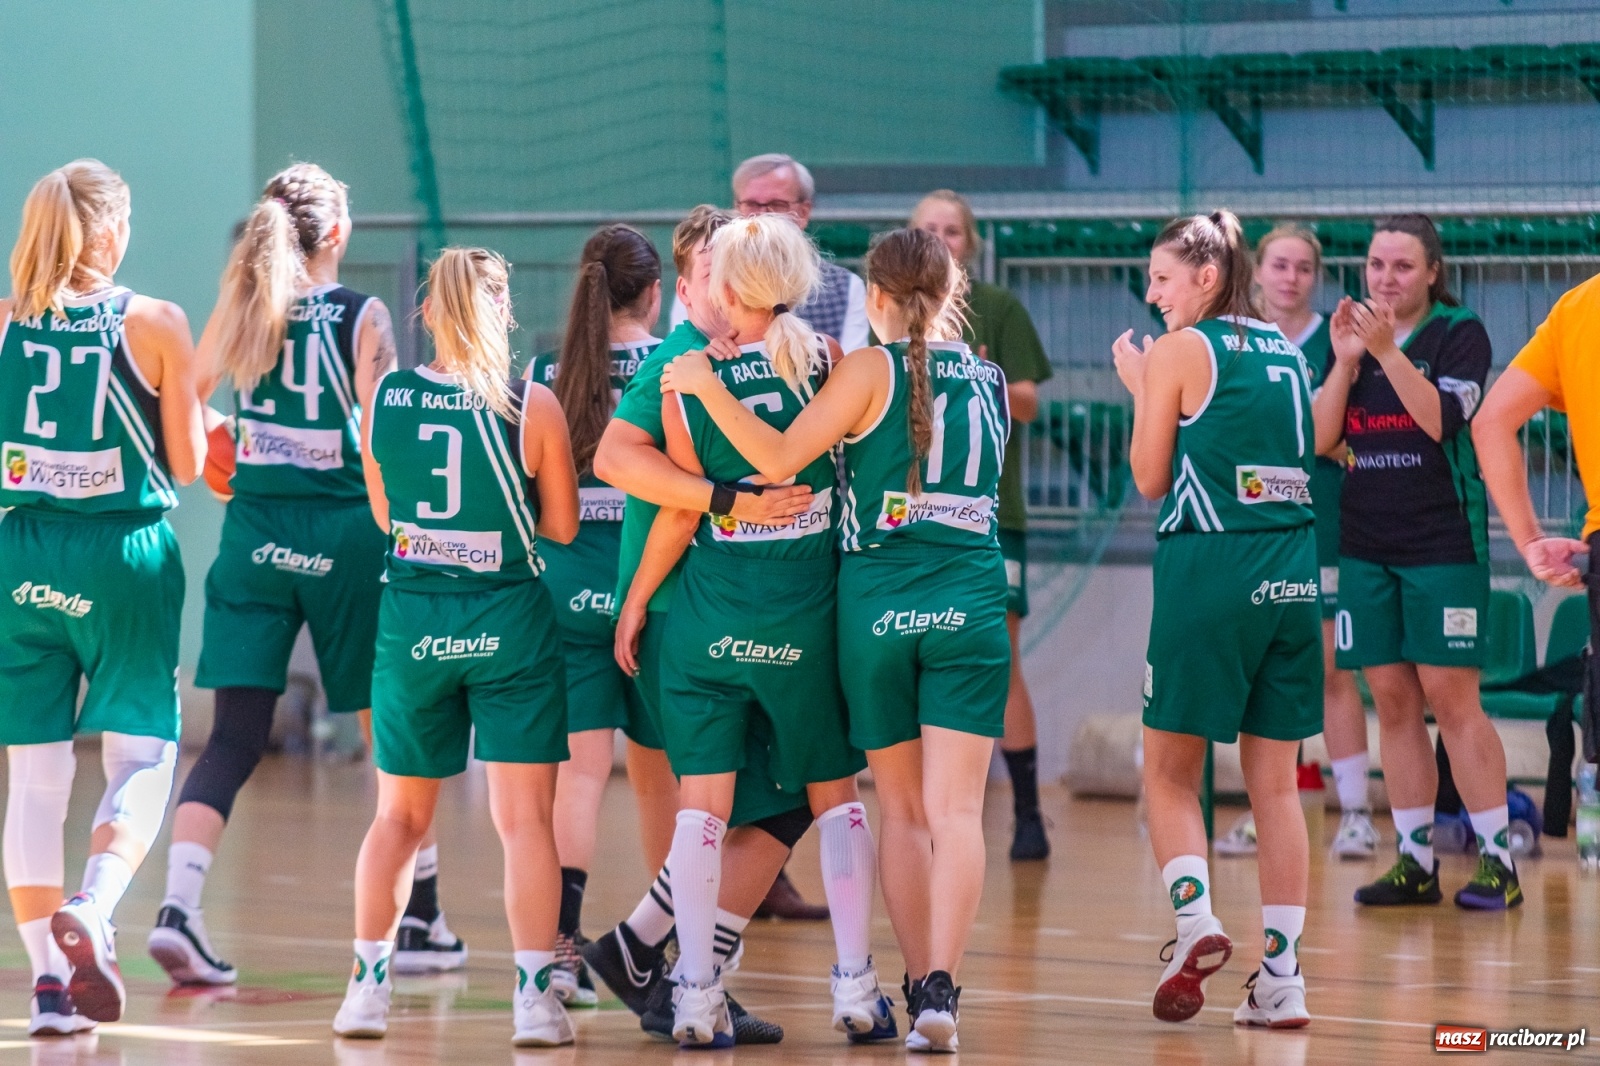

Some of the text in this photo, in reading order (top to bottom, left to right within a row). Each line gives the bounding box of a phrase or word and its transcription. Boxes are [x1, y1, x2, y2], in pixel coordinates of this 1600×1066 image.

[22, 340, 112, 440] 27
[384, 388, 415, 407] RKK
[1266, 365, 1305, 458] 7
[926, 392, 983, 487] 11
[416, 423, 463, 520] 3
[1355, 453, 1422, 470] WAGTECH
[271, 547, 334, 572] Clavis
[30, 584, 94, 614] Clavis
[1269, 578, 1318, 599] Clavis
[894, 607, 967, 630] Clavis
[431, 632, 500, 656] Clavis
[731, 640, 803, 661] Clavis
